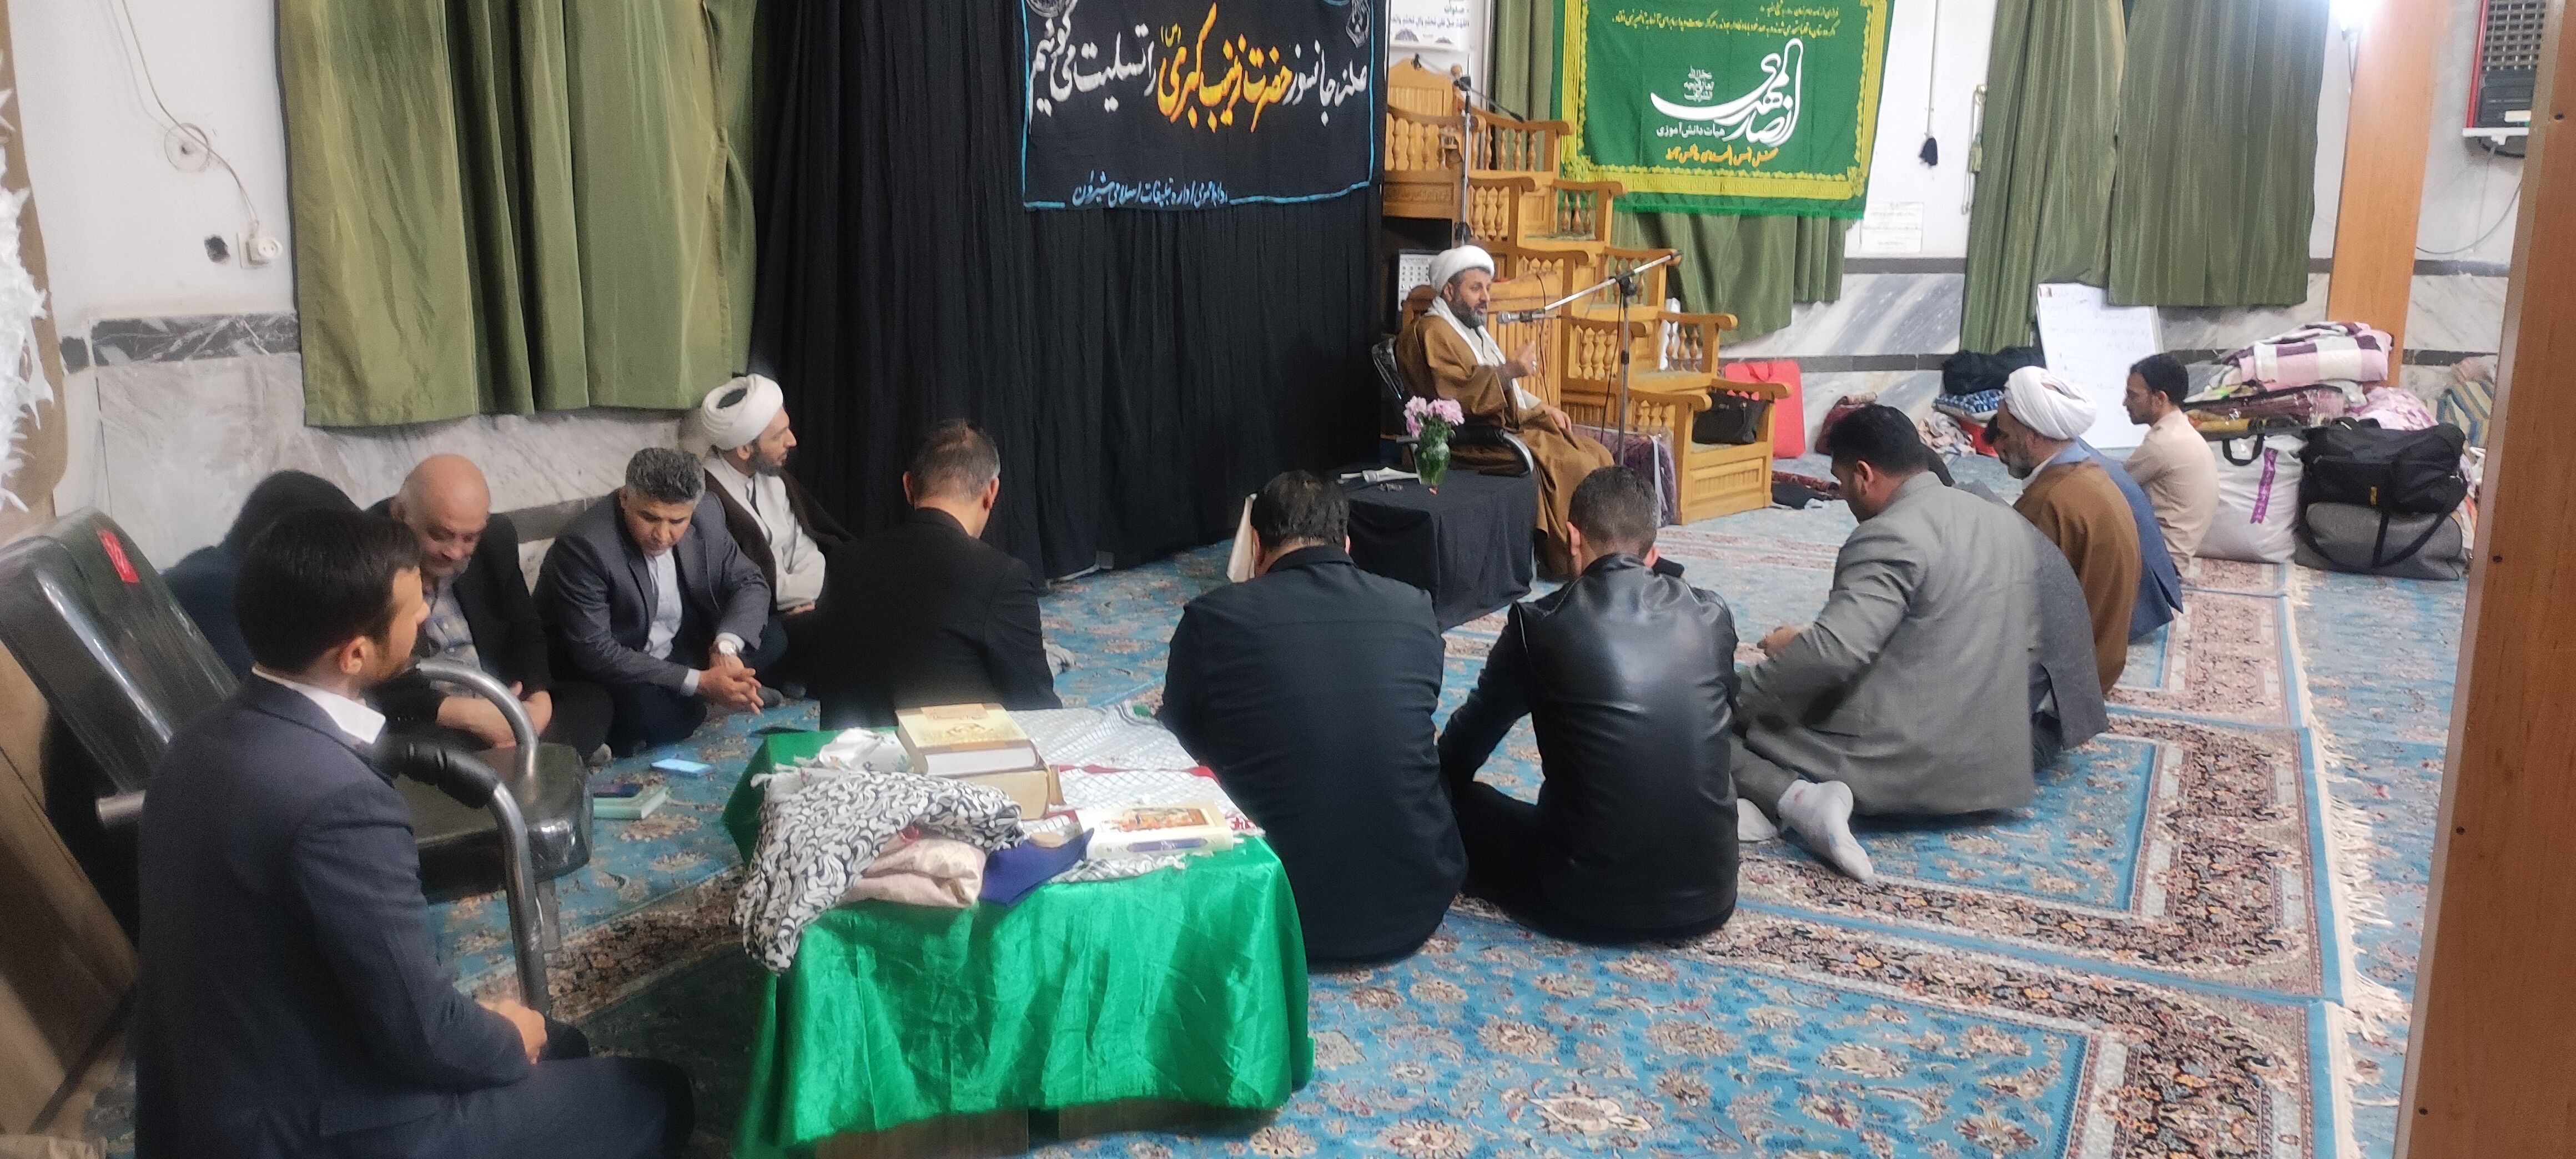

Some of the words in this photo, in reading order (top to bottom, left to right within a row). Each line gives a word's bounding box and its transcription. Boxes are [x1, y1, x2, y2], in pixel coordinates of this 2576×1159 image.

[1073, 23, 1149, 113] تسلیت
[1144, 40, 1155, 97] را
[1158, 2, 1216, 129] کبری
[1199, 33, 1247, 133] زینب
[1244, 46, 1293, 133] حضرت
[1282, 39, 1336, 127] جانسوز
